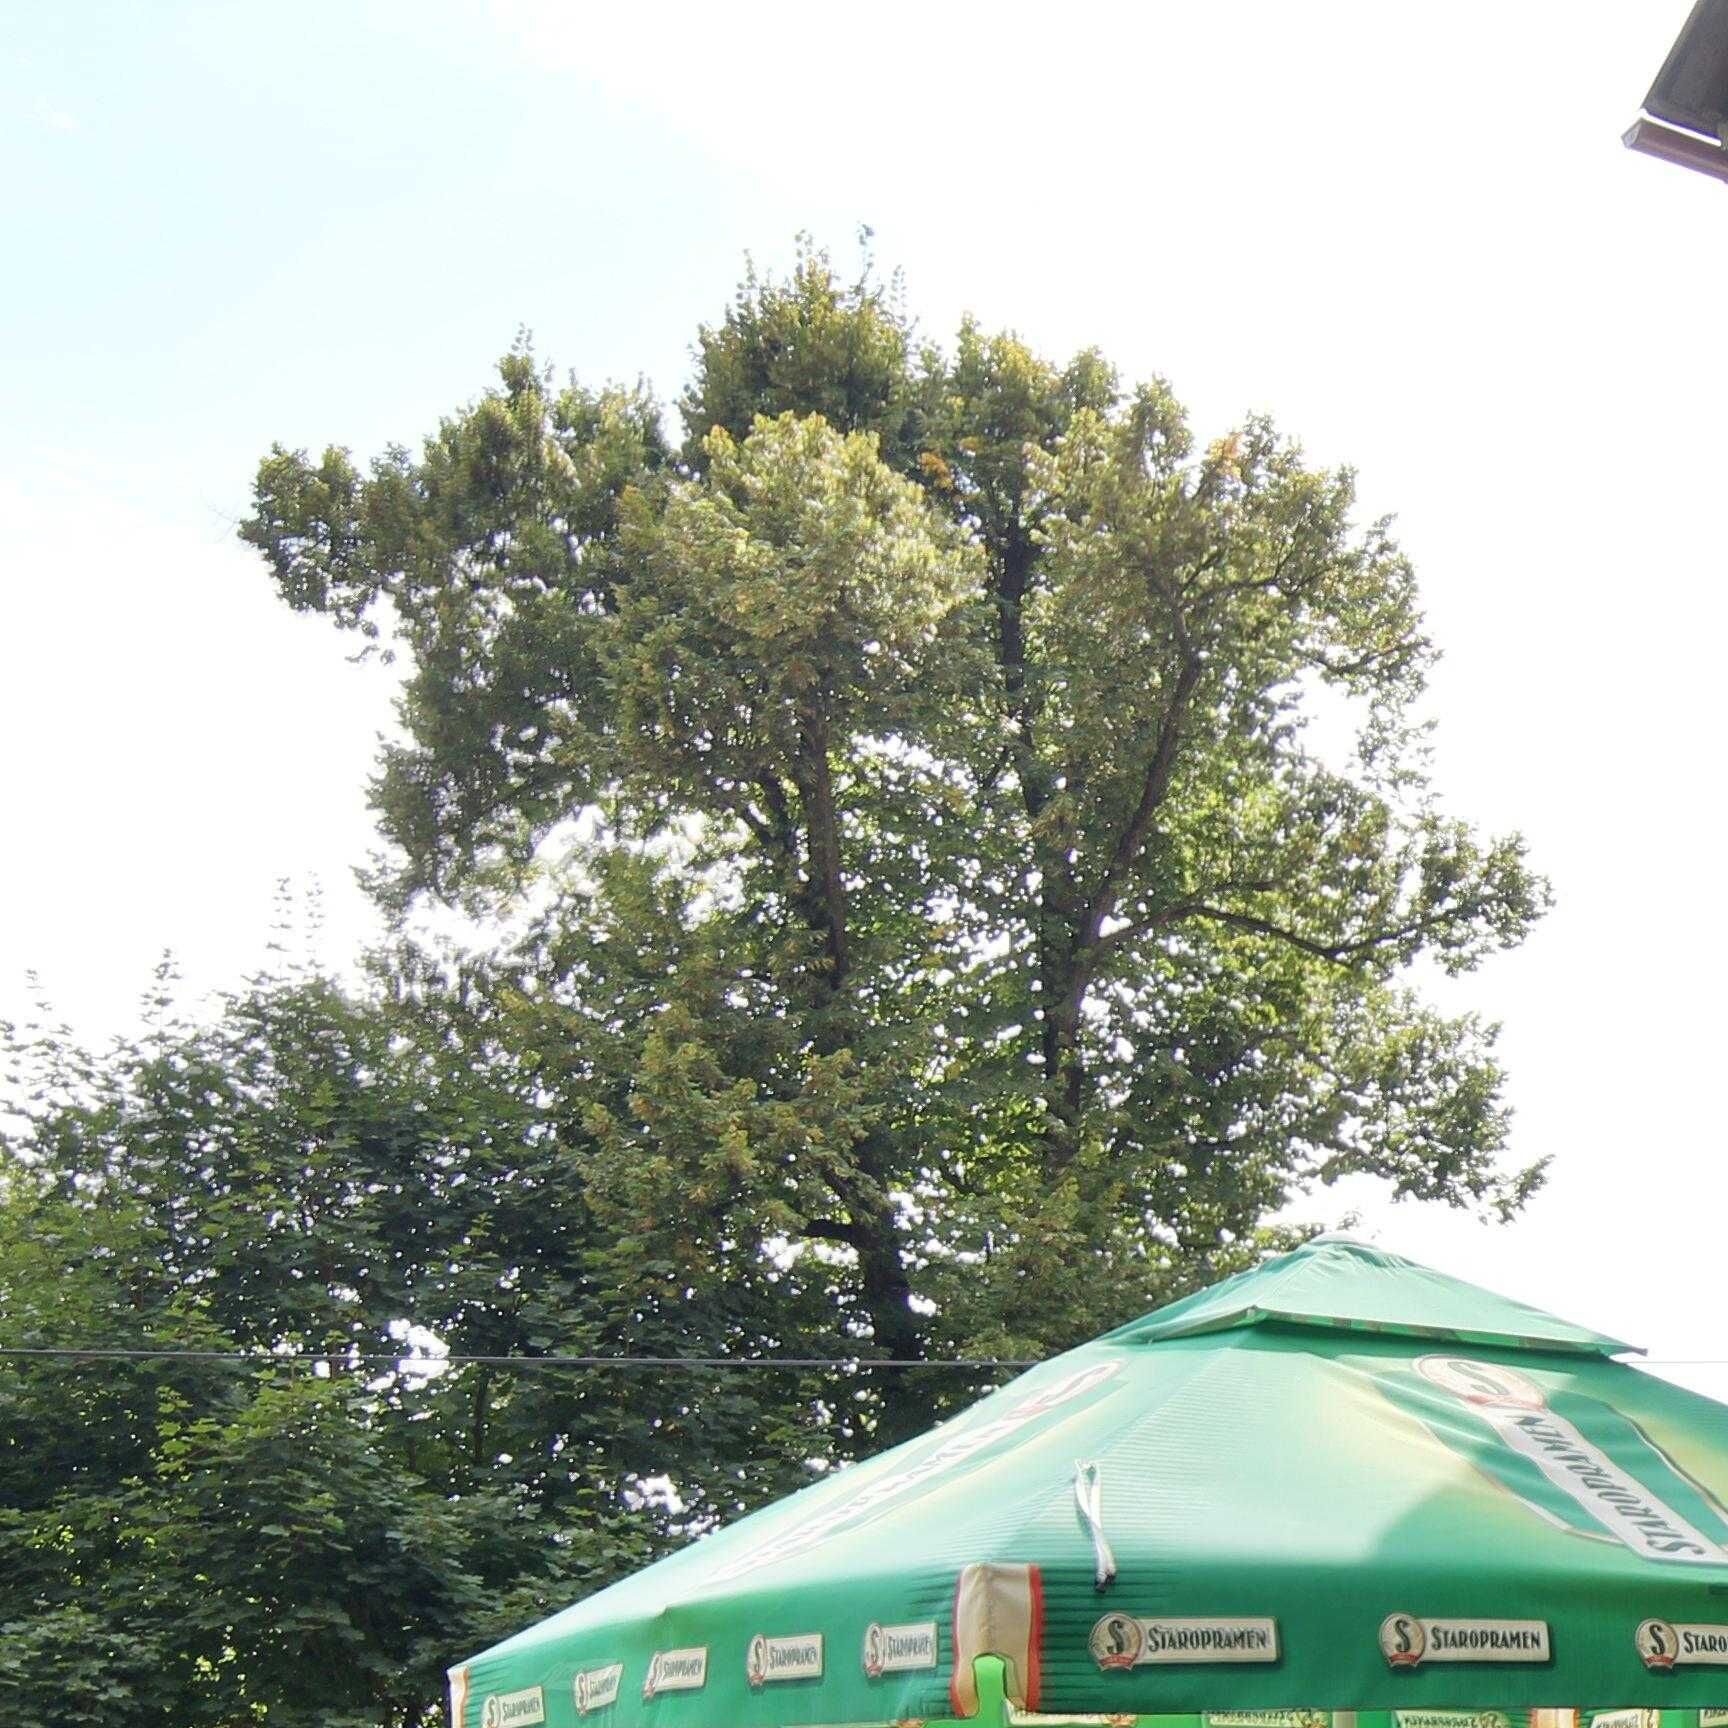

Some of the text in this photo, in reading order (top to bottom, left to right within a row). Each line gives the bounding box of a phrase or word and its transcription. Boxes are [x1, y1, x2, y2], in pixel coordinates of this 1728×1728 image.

[1504, 1414, 1706, 1556] STAROPRAMEN
[1147, 1625, 1268, 1653] STAROPRAMEN
[1430, 1627, 1541, 1651] STAROPRAMEN
